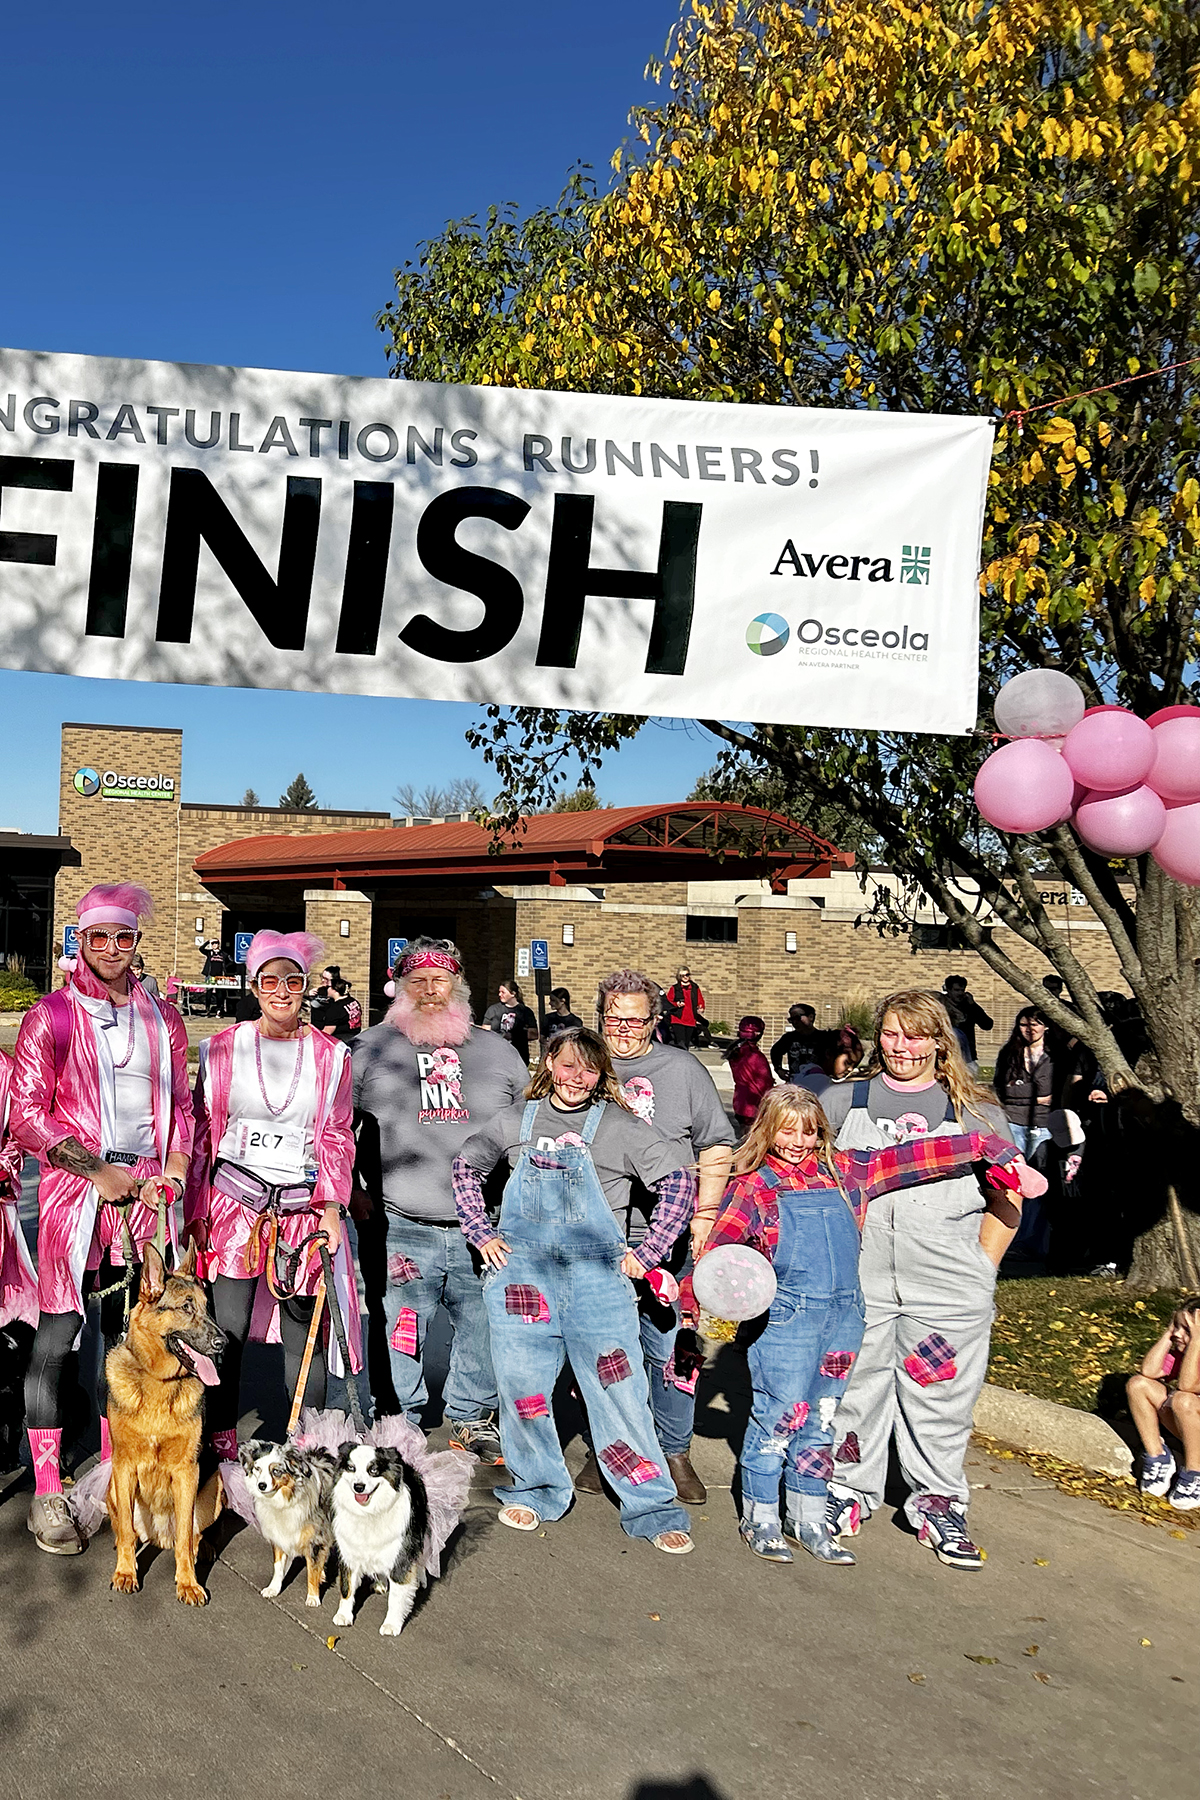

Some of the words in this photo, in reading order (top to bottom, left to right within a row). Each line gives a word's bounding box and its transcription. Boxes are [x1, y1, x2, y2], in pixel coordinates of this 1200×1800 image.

[522, 433, 820, 489] RUNNERS!
[770, 538, 894, 582] Avera
[797, 618, 929, 651] Osceola
[798, 646, 849, 658] REGIONAL
[851, 649, 889, 660] HEALTH
[891, 652, 928, 662] CENTER
[102, 770, 174, 790] Osceola
[418, 1109, 470, 1124] pumpkin
[250, 1132, 283, 1149] 207
